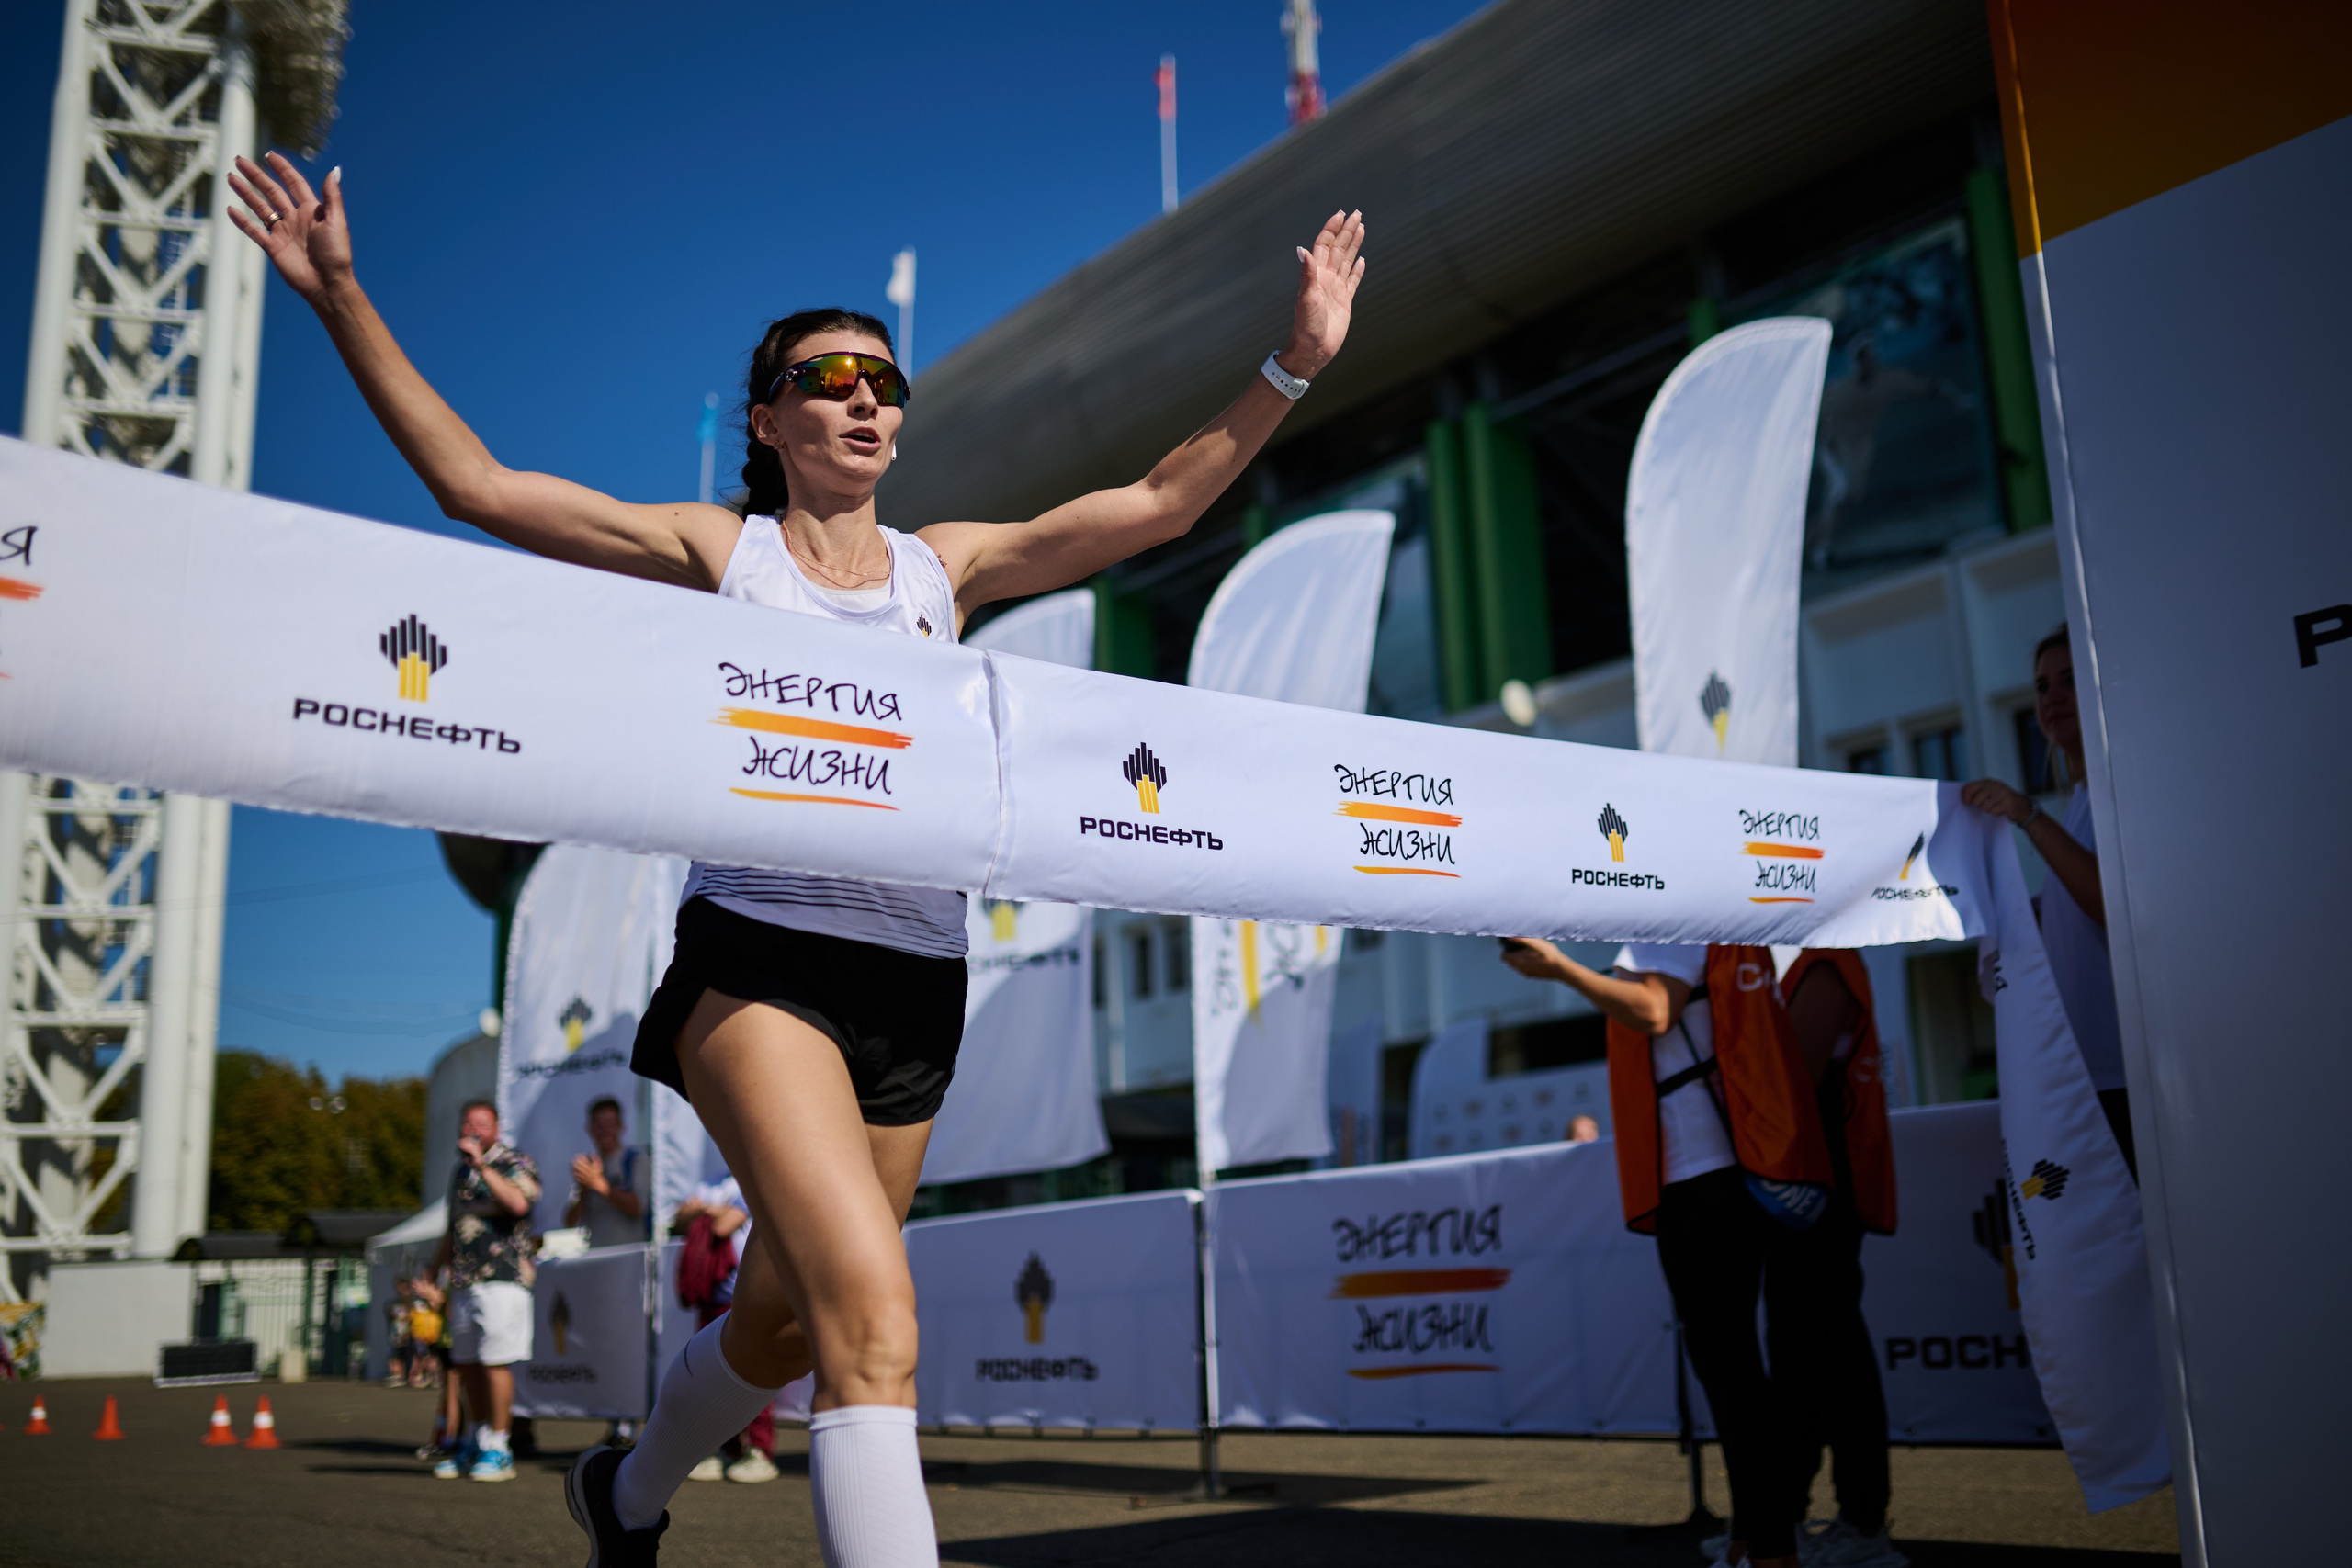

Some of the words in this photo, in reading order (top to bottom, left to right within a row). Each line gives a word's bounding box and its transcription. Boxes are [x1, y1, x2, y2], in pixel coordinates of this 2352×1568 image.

[718, 661, 903, 721] ЭНЕРГИЯ
[292, 697, 522, 755] РОСНЕФТЬ
[742, 735, 892, 795] ЖИЗНИ
[1333, 763, 1454, 806] ЭНЕРГИЯ
[1079, 815, 1224, 851] РОСНЕФТЬ
[1358, 822, 1456, 866] ЖИЗНИ
[1738, 808, 1820, 841] ЭНЕРГИЯ
[1570, 867, 1666, 891] РОСНЕФТЬ
[1754, 862, 1817, 894] ЖИЗНИ
[1331, 1203, 1504, 1263] ЭНЕРГИЯ
[1352, 1303, 1495, 1355] ЖИЗНИ
